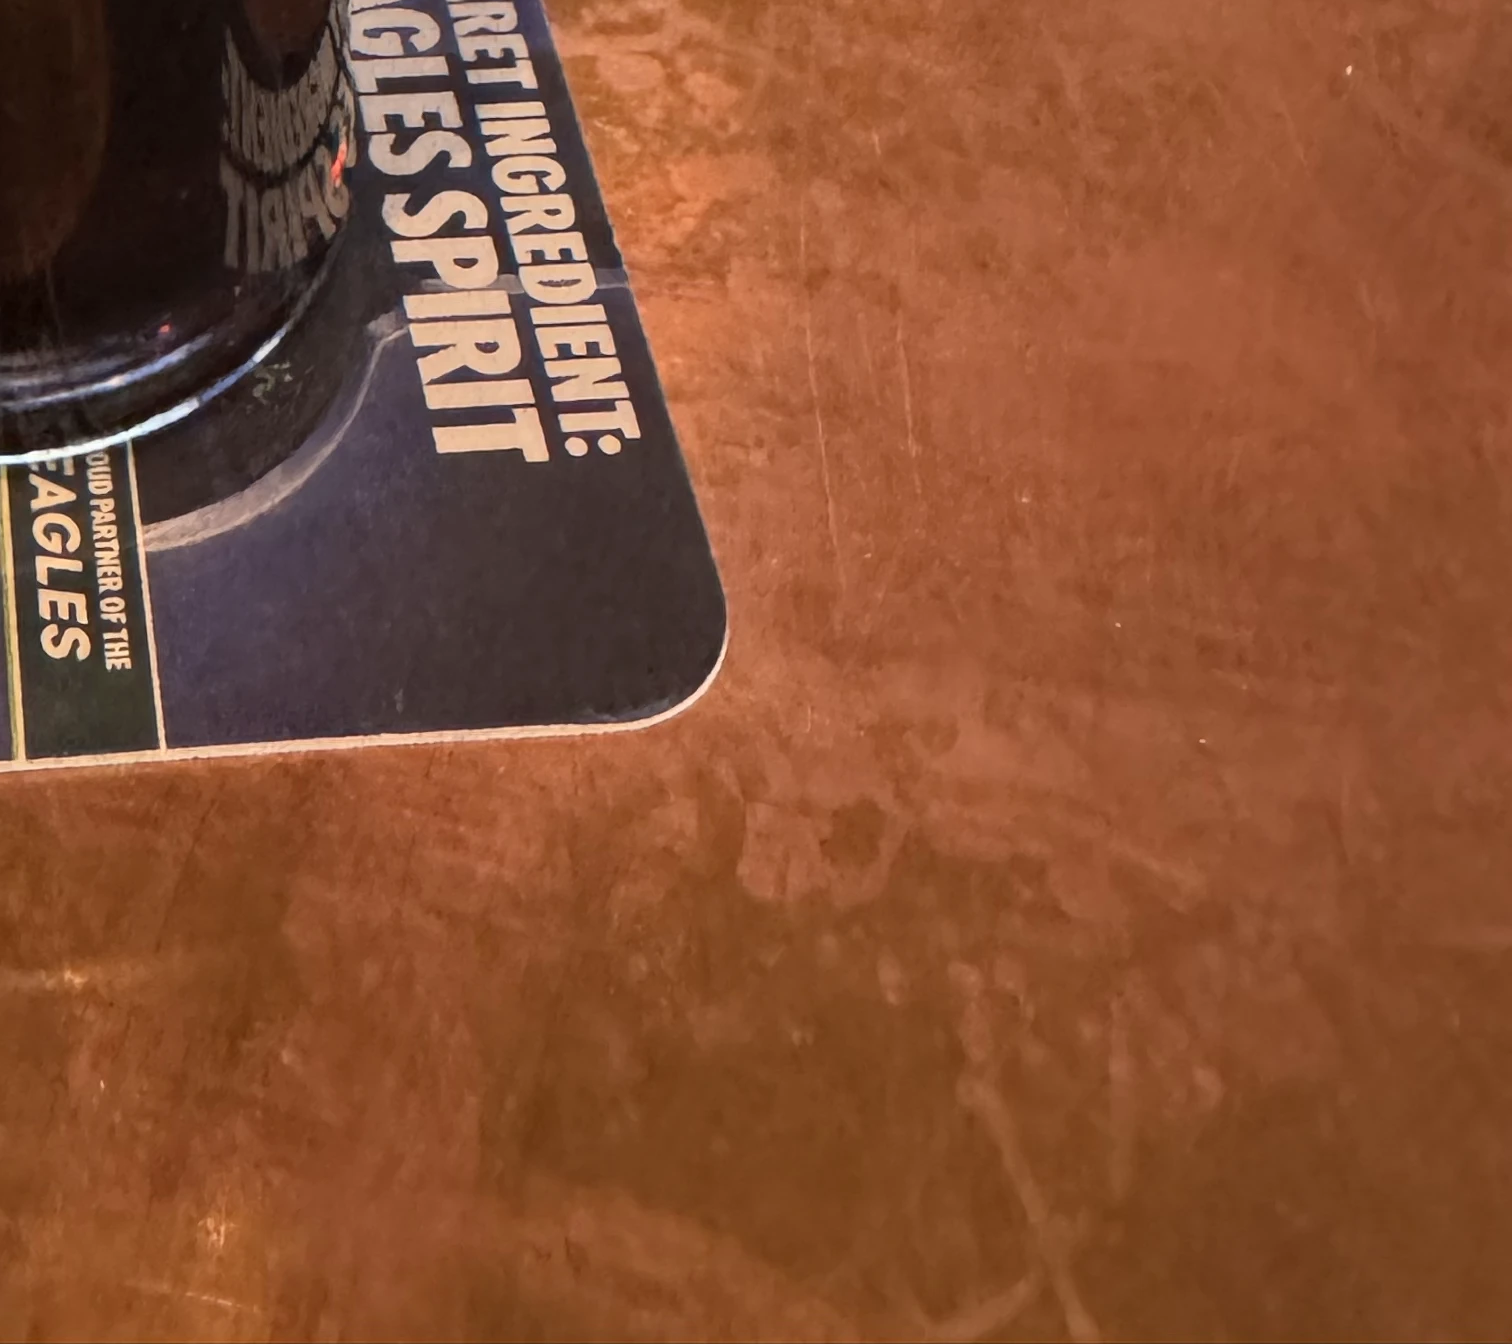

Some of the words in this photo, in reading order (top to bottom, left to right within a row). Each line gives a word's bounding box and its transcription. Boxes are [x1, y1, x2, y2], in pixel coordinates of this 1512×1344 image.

[474, 100, 642, 457] INGREDIENT:
[381, 189, 550, 463] SPIRIT
[85, 452, 114, 495] OUD
[89, 498, 124, 596] PARTNER
[99, 596, 127, 625] OF
[103, 628, 133, 672] THE
